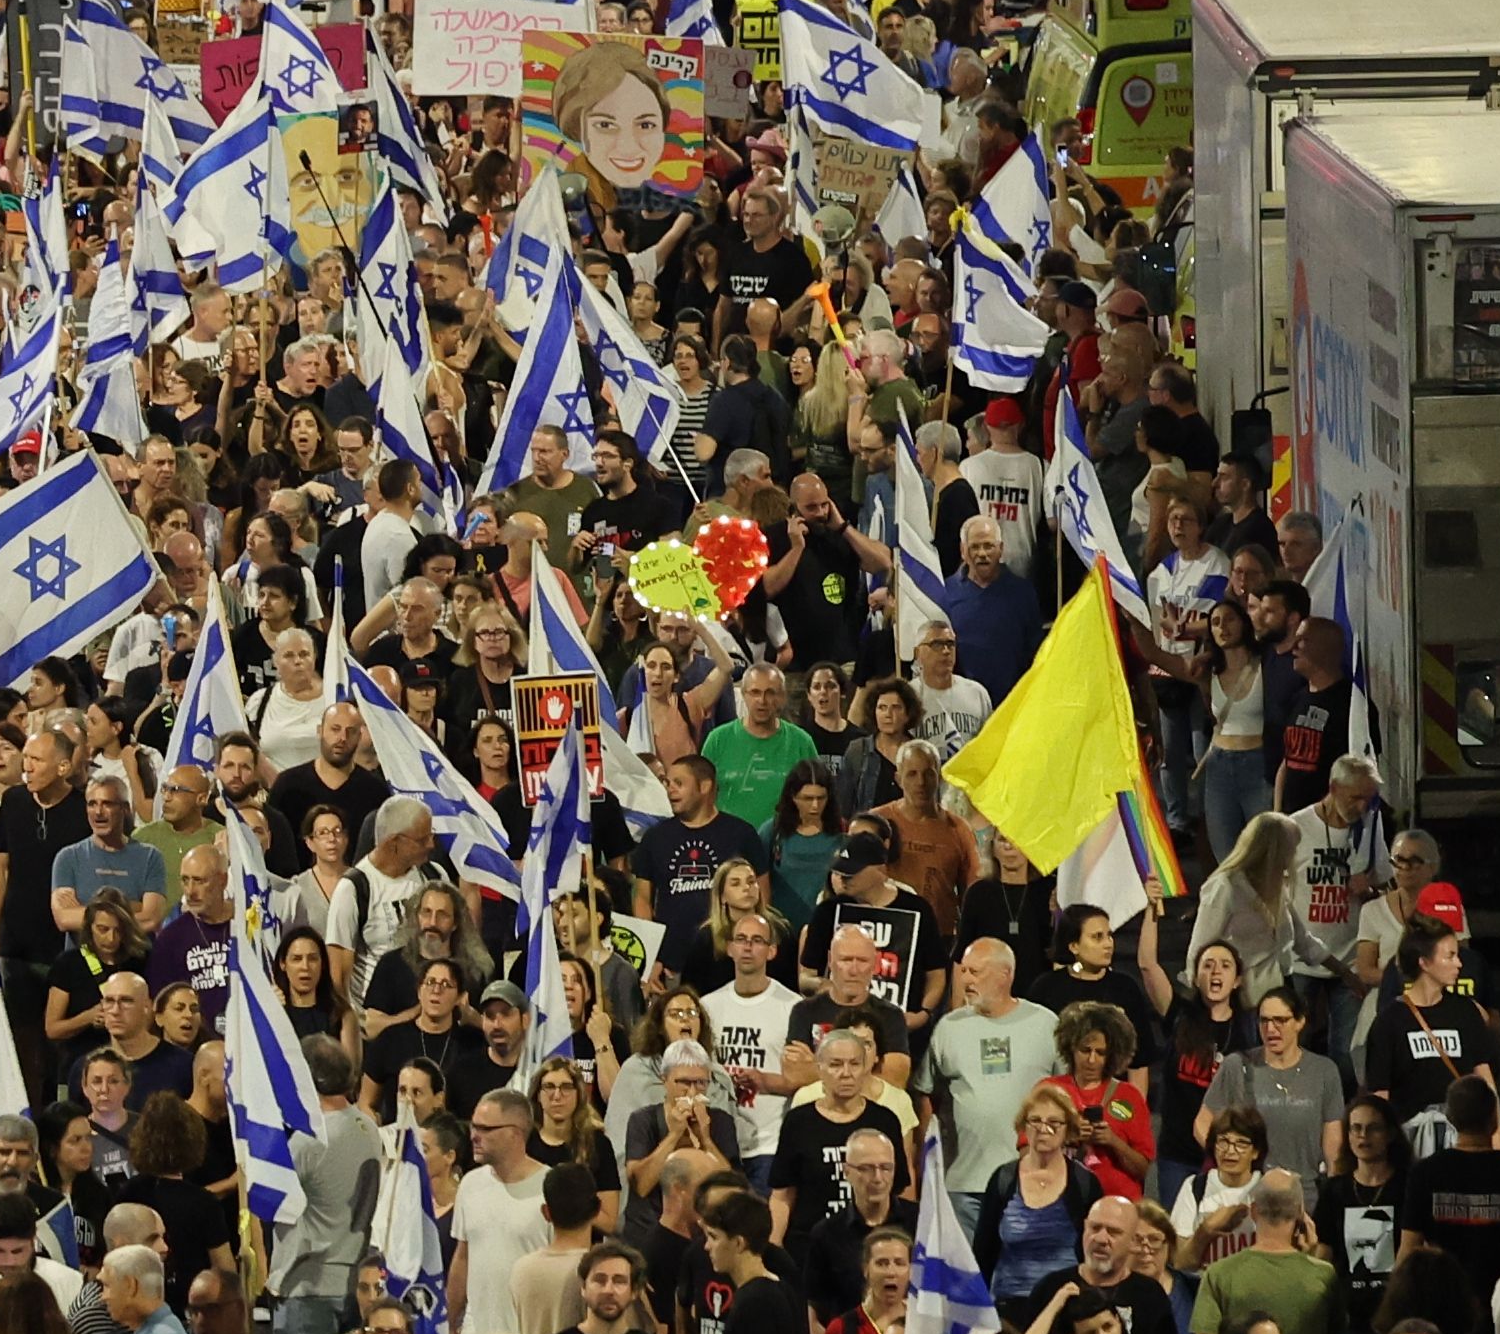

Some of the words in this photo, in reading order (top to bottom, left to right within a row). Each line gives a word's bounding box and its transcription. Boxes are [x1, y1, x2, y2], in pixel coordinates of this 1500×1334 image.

[651, 52, 694, 80] קרינה
[979, 483, 1029, 505] בחירות
[1311, 885, 1349, 905] אתה
[1308, 904, 1349, 924] אשם
[721, 1025, 762, 1047] אתה
[715, 1046, 766, 1069] הראש
